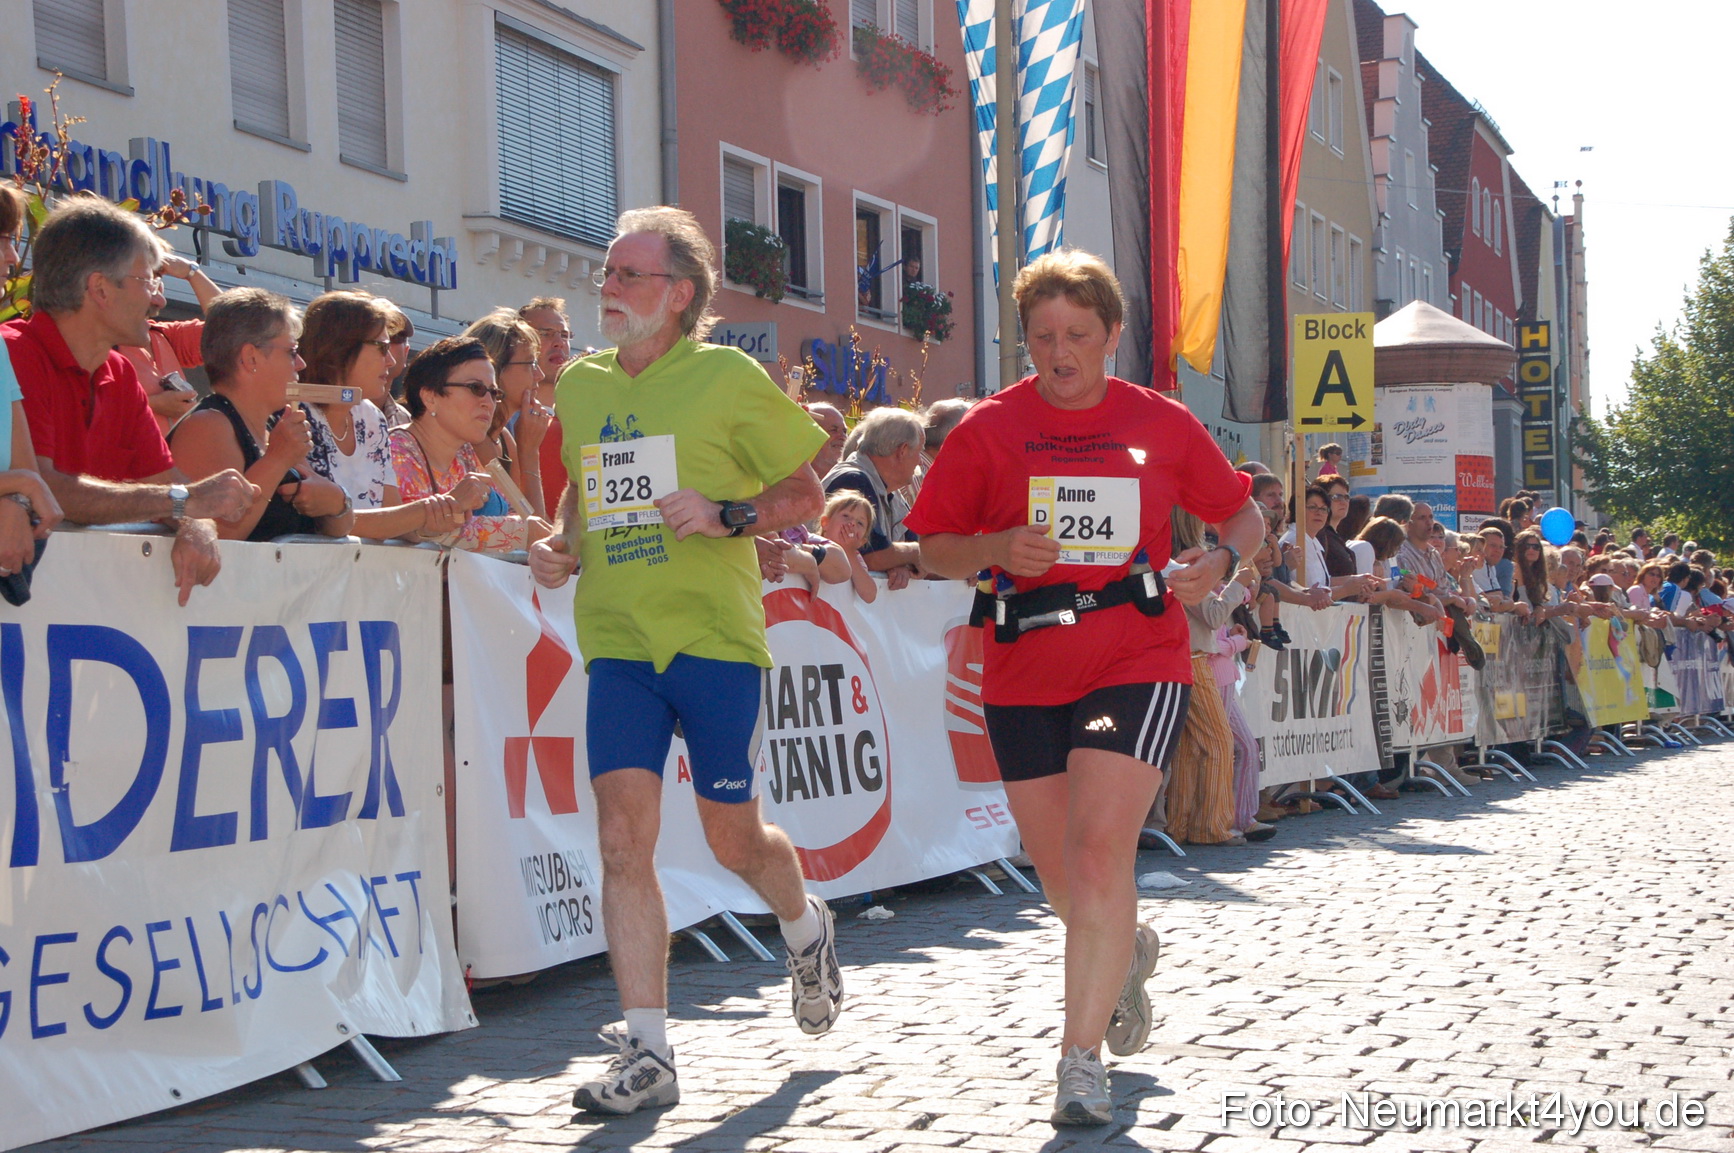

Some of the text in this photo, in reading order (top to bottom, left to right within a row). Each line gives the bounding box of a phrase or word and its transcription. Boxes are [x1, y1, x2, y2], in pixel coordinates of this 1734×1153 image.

[258, 180, 457, 289] Rupprecht
[1304, 318, 1367, 341] Block
[1311, 349, 1358, 407] A
[1519, 324, 1551, 487] HOTEL
[1393, 416, 1427, 436] Dirty
[1025, 440, 1128, 454] Rotkreuzheim
[1039, 432, 1112, 443] Laufteam
[602, 450, 635, 468] Franz
[1050, 455, 1105, 464] Regensburg
[587, 475, 653, 504] D 328
[1056, 486, 1096, 502] Anne
[1035, 509, 1114, 540] D 284
[605, 533, 663, 554] Regensburg
[607, 545, 665, 567] Marathon
[646, 554, 669, 567] 2005
[851, 675, 869, 715] &
[769, 729, 883, 805] JÄNIG
[726, 778, 747, 790] asics
[965, 802, 1011, 830] SE
[0, 870, 423, 1040] ESELLSCHAFT
